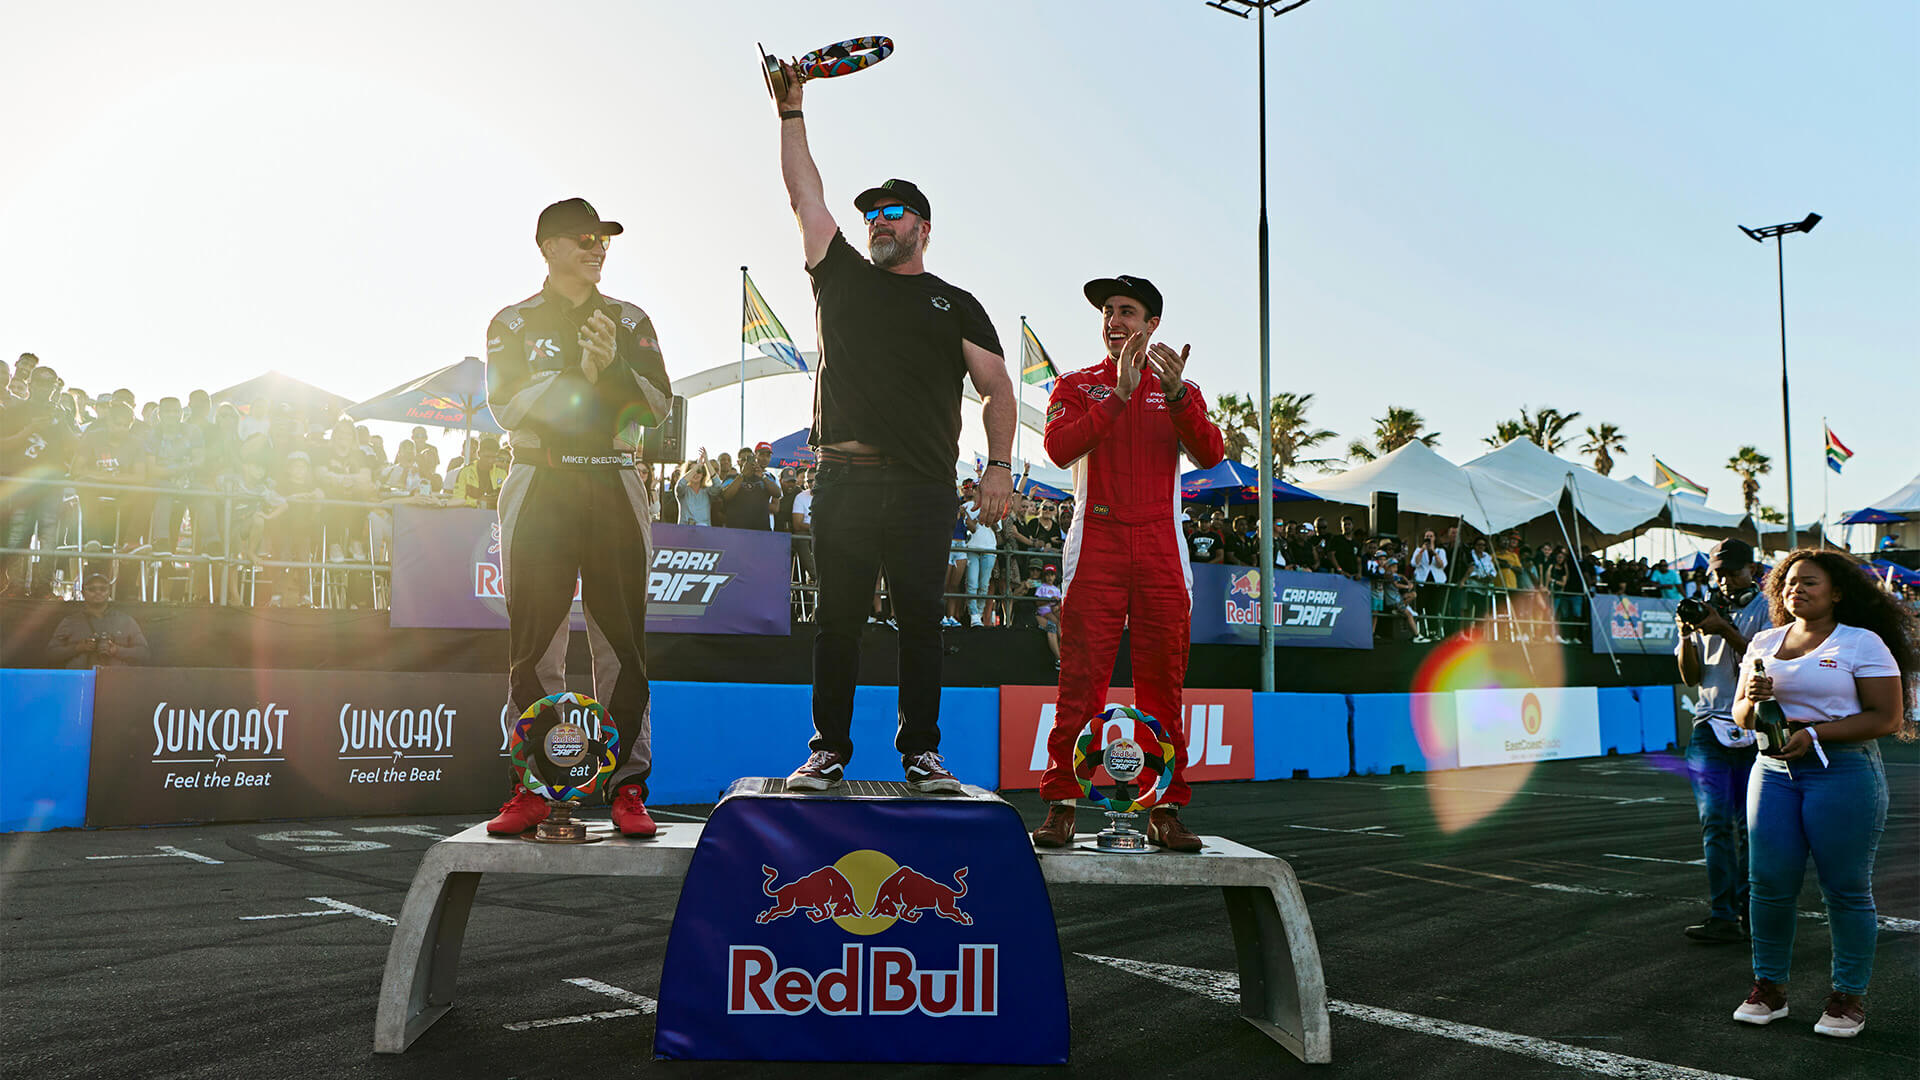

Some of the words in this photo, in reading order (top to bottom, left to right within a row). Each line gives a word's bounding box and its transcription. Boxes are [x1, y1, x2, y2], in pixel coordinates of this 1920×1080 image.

[562, 455, 589, 464] MIKEY
[591, 456, 622, 464] SKELTON
[652, 550, 719, 571] PARK
[647, 573, 729, 602] RIFT
[1282, 588, 1307, 603] CAR
[1307, 590, 1338, 605] PARK
[1225, 600, 1254, 624] Red
[1254, 601, 1283, 626] Bll
[1285, 605, 1343, 627] DRIFT
[153, 702, 289, 756] SUNCOAST
[338, 703, 457, 753] SUNCOAST
[164, 772, 199, 788] Feel
[204, 771, 231, 787] the
[234, 771, 272, 787] Beat
[349, 768, 380, 783] Feel
[383, 768, 407, 782] the
[409, 767, 442, 782] Beat
[570, 764, 591, 777] eat
[727, 943, 863, 1016] Red
[869, 943, 998, 1017] Bull
